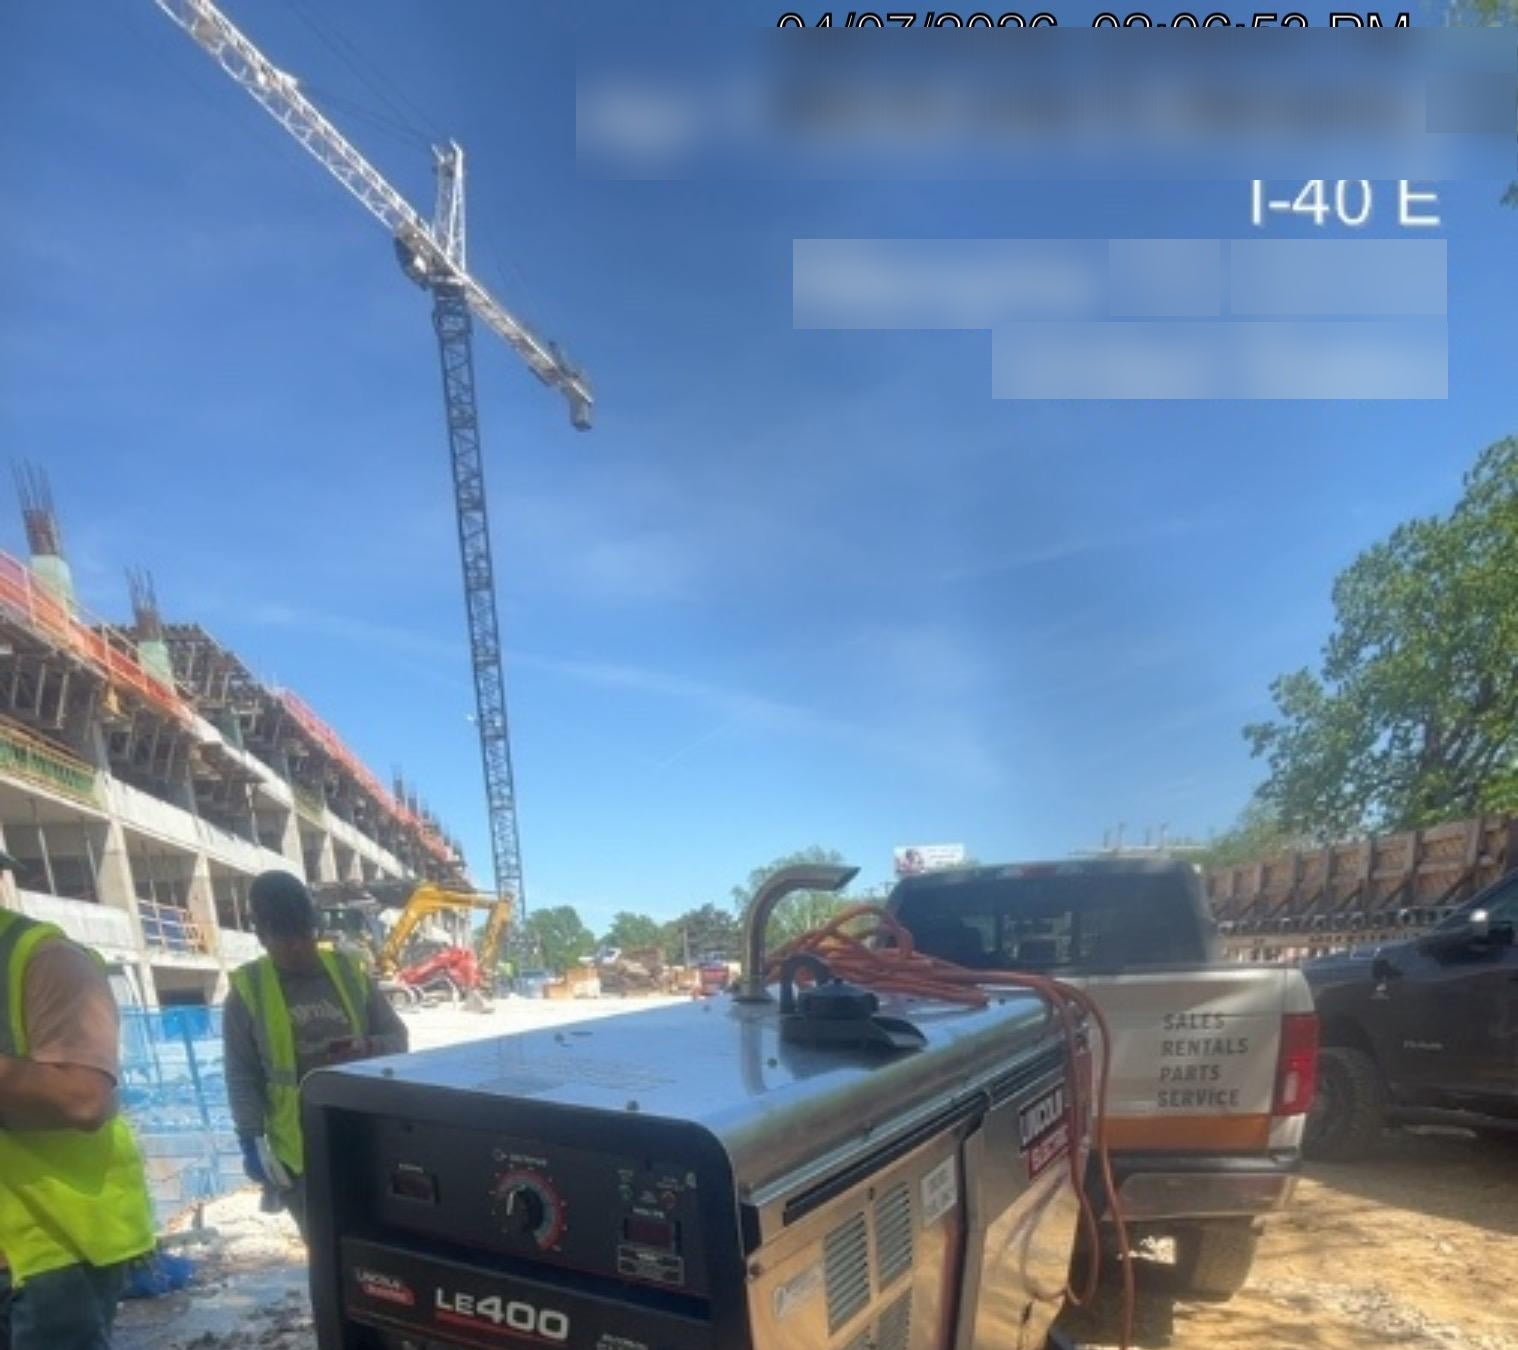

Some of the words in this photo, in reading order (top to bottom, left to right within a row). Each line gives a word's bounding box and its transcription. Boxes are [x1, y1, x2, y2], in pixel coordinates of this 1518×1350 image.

[1163, 1013, 1225, 1030] SALES
[1161, 1037, 1249, 1057] RENTALS
[1159, 1064, 1219, 1081] PARTS
[1157, 1088, 1240, 1107] SERVICE
[436, 1286, 570, 1340] LE400
